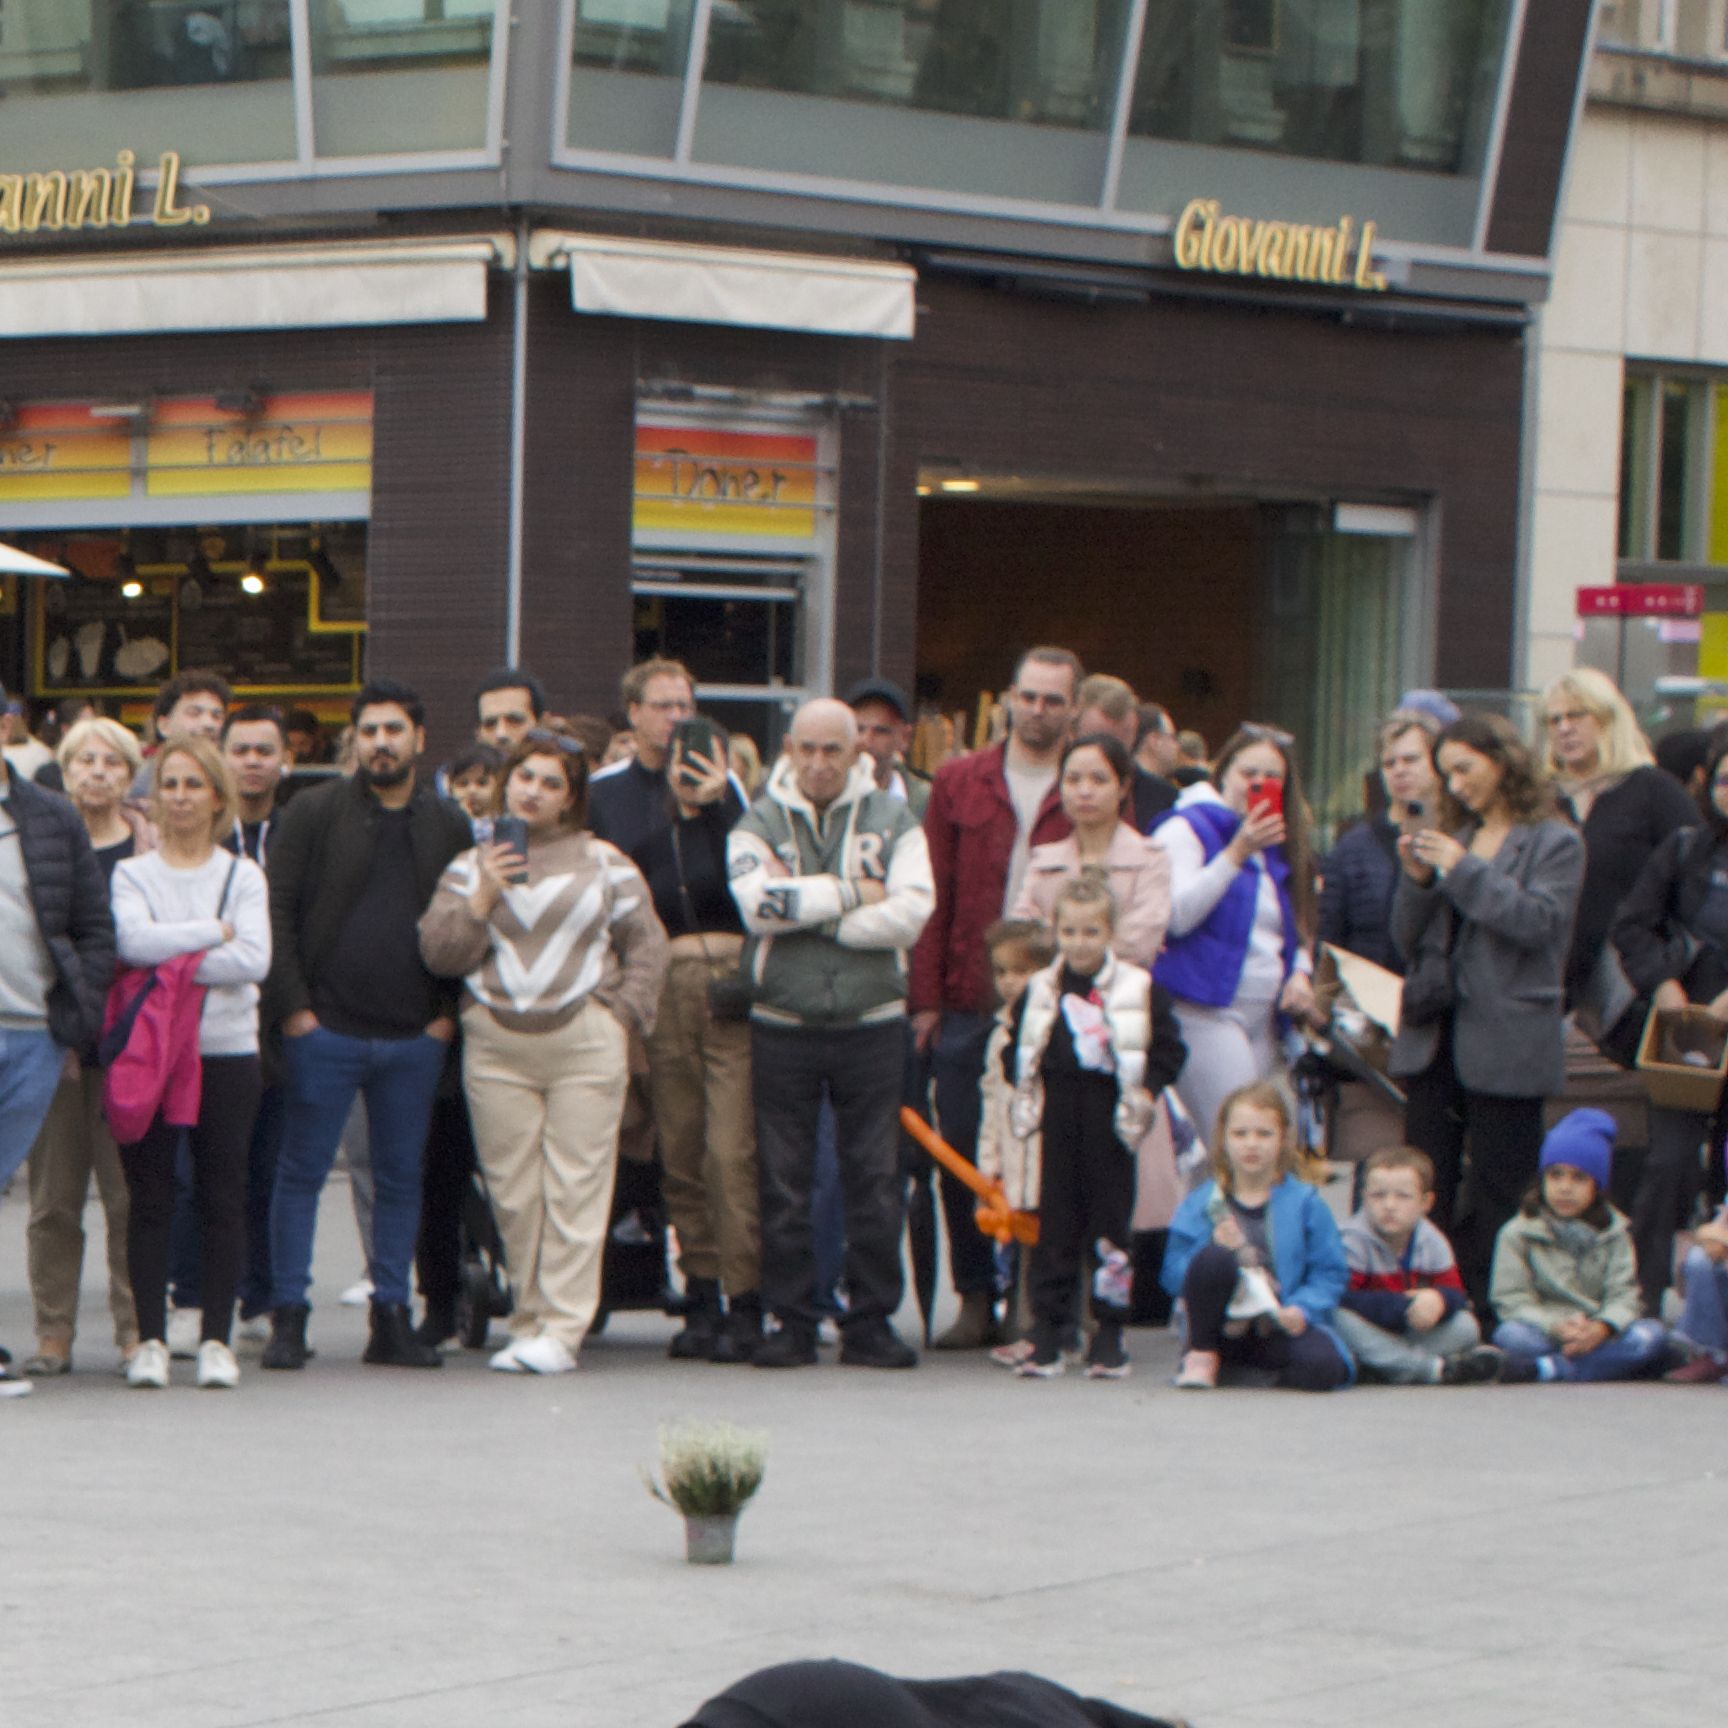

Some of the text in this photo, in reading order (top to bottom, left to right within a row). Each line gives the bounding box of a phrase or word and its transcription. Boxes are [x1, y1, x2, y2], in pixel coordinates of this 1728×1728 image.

[153, 150, 212, 226] L.
[1174, 197, 1389, 291] Giovanni L.
